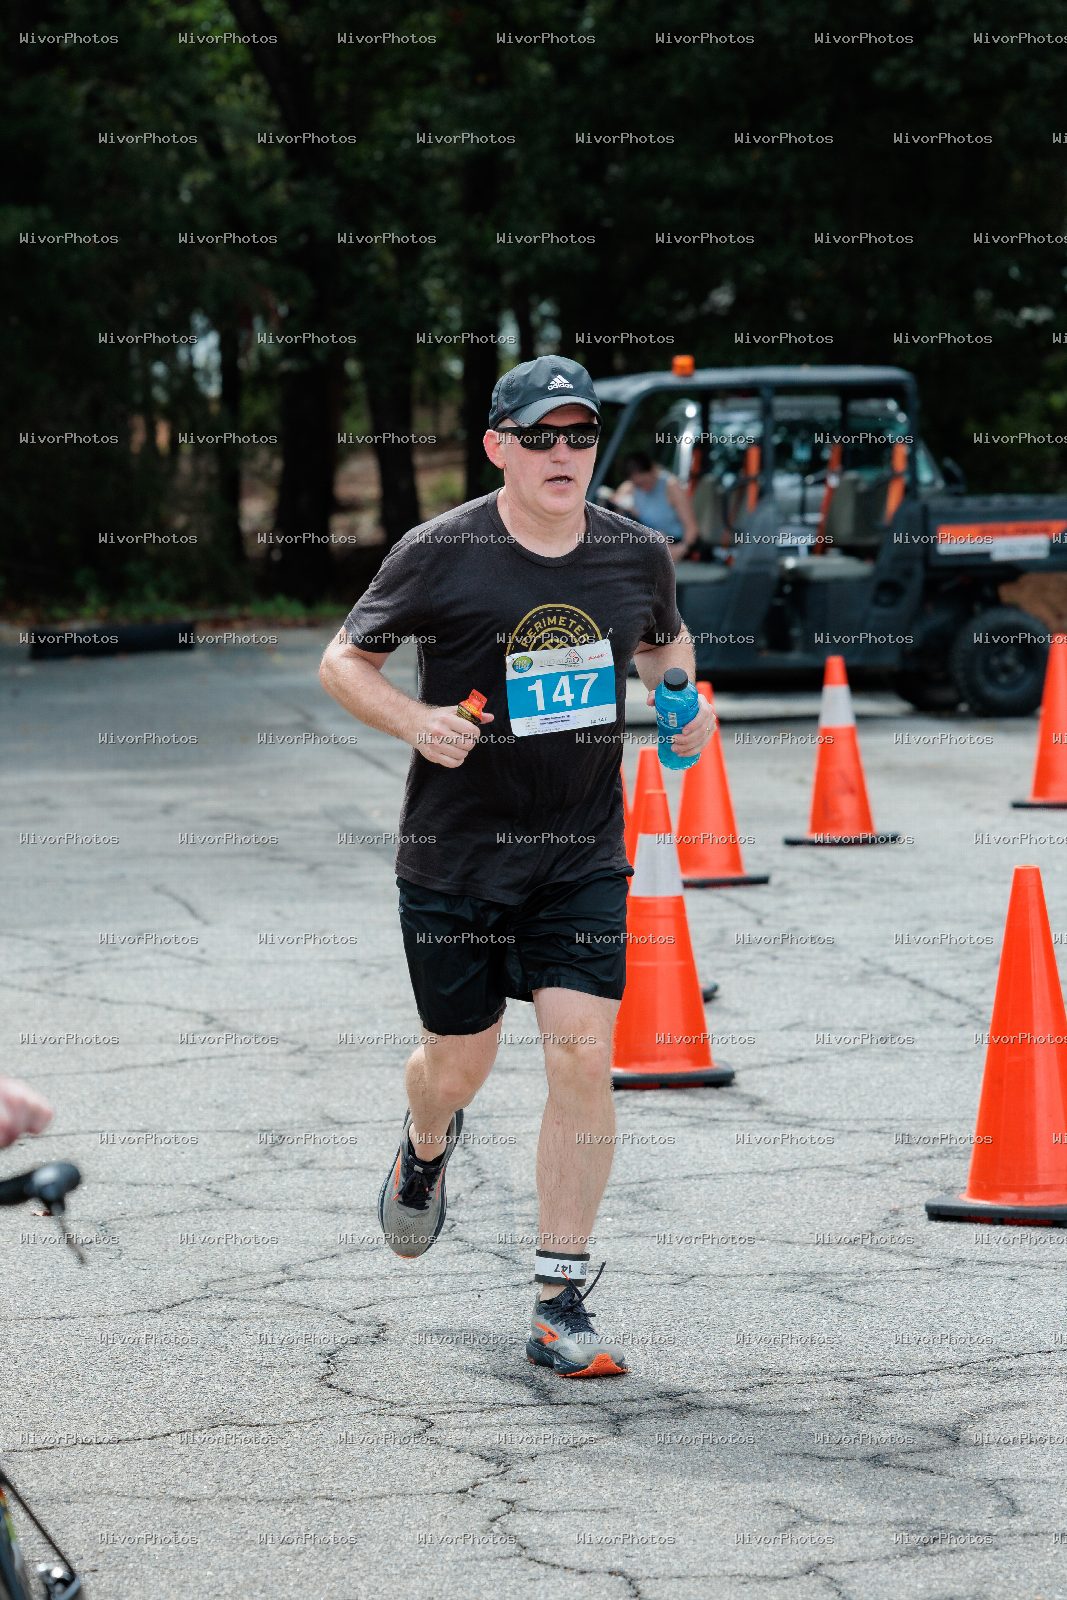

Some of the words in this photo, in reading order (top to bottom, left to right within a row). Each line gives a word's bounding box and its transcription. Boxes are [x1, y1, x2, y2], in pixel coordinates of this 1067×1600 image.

[547, 382, 574, 391] adidas
[527, 672, 599, 711] 147
[554, 1263, 573, 1274] 147
